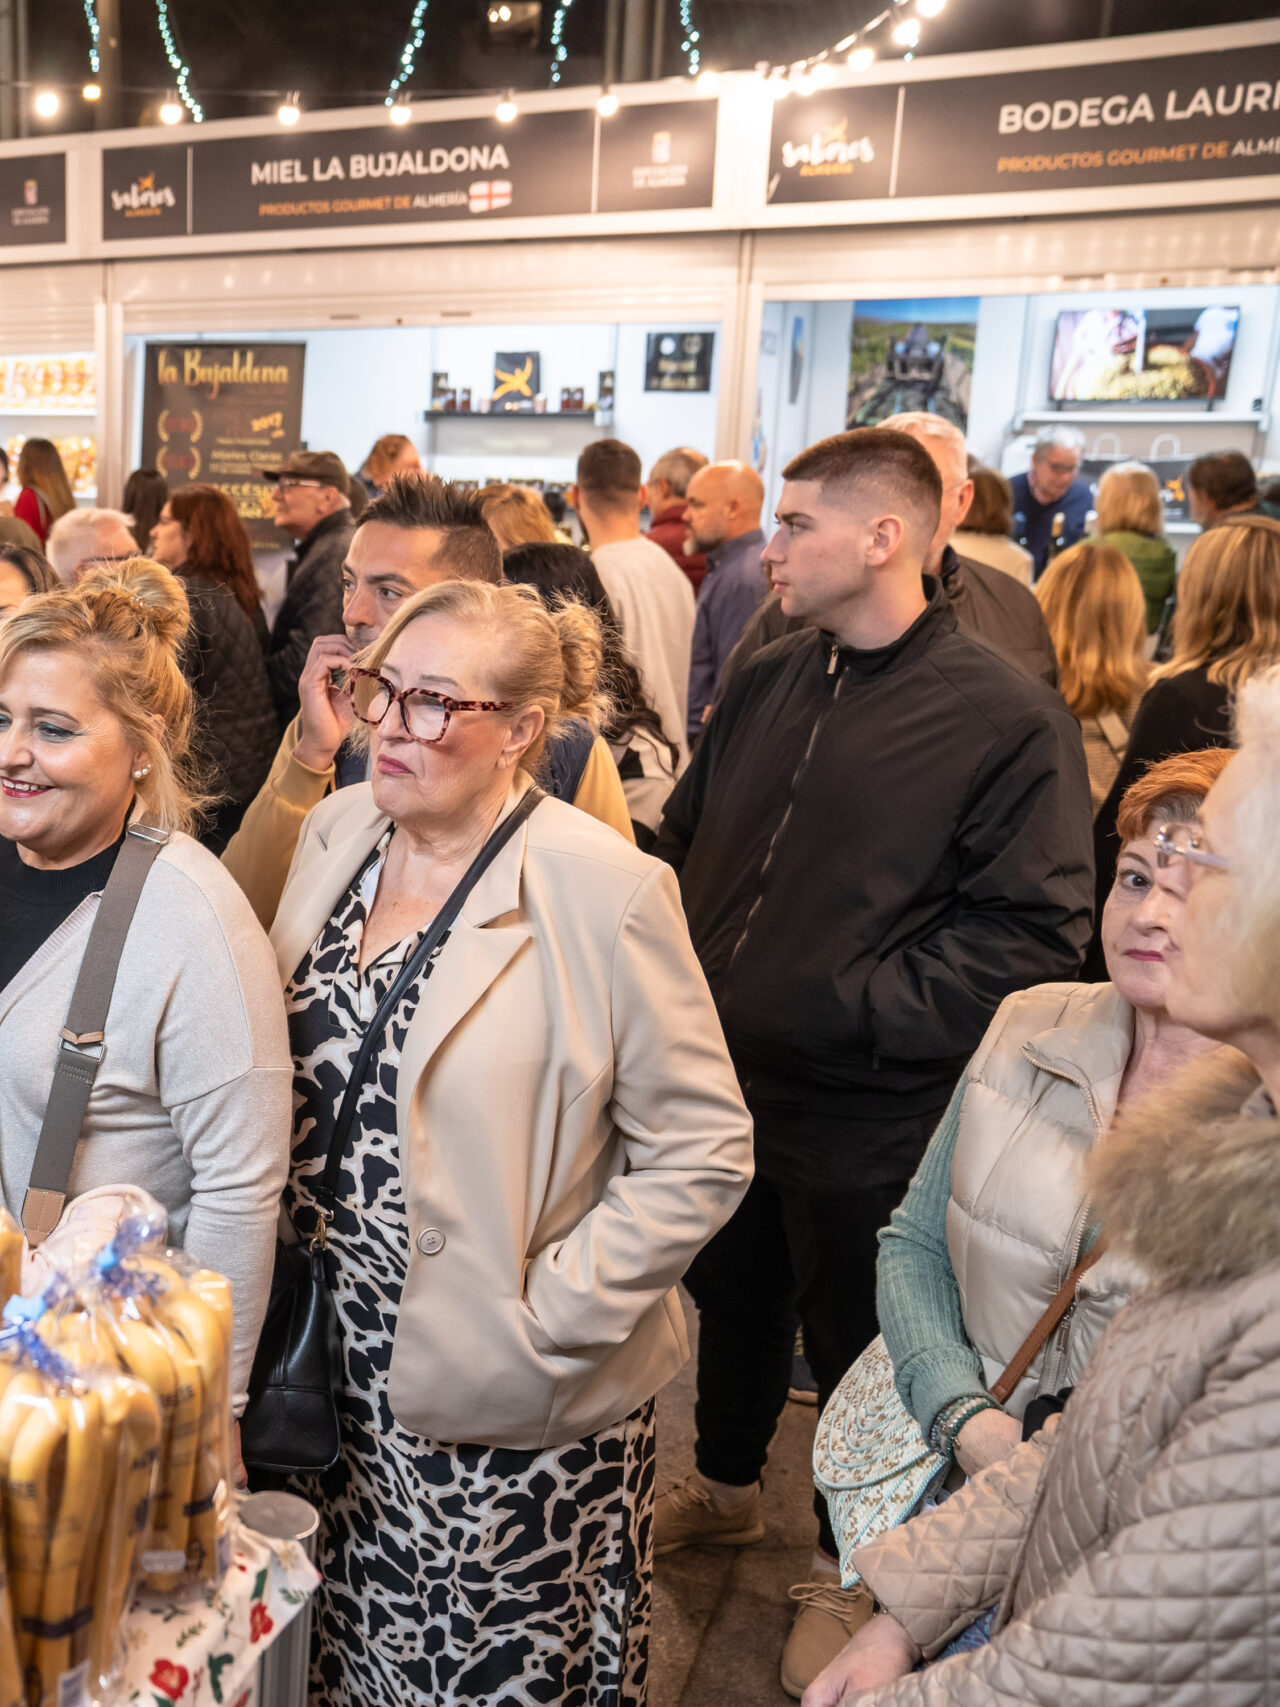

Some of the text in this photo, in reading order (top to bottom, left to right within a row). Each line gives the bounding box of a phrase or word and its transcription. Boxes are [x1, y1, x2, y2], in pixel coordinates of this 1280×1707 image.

[998, 92, 1154, 134] BODEGA
[251, 143, 510, 185] MIEL LA BUJALDONA
[997, 150, 1104, 173] PRODUCTOS
[1106, 142, 1200, 167] GOURMET
[1201, 140, 1229, 159] DE
[258, 200, 330, 217] PRODUCTOS
[332, 195, 392, 214] GOURMET
[393, 194, 411, 209] DE
